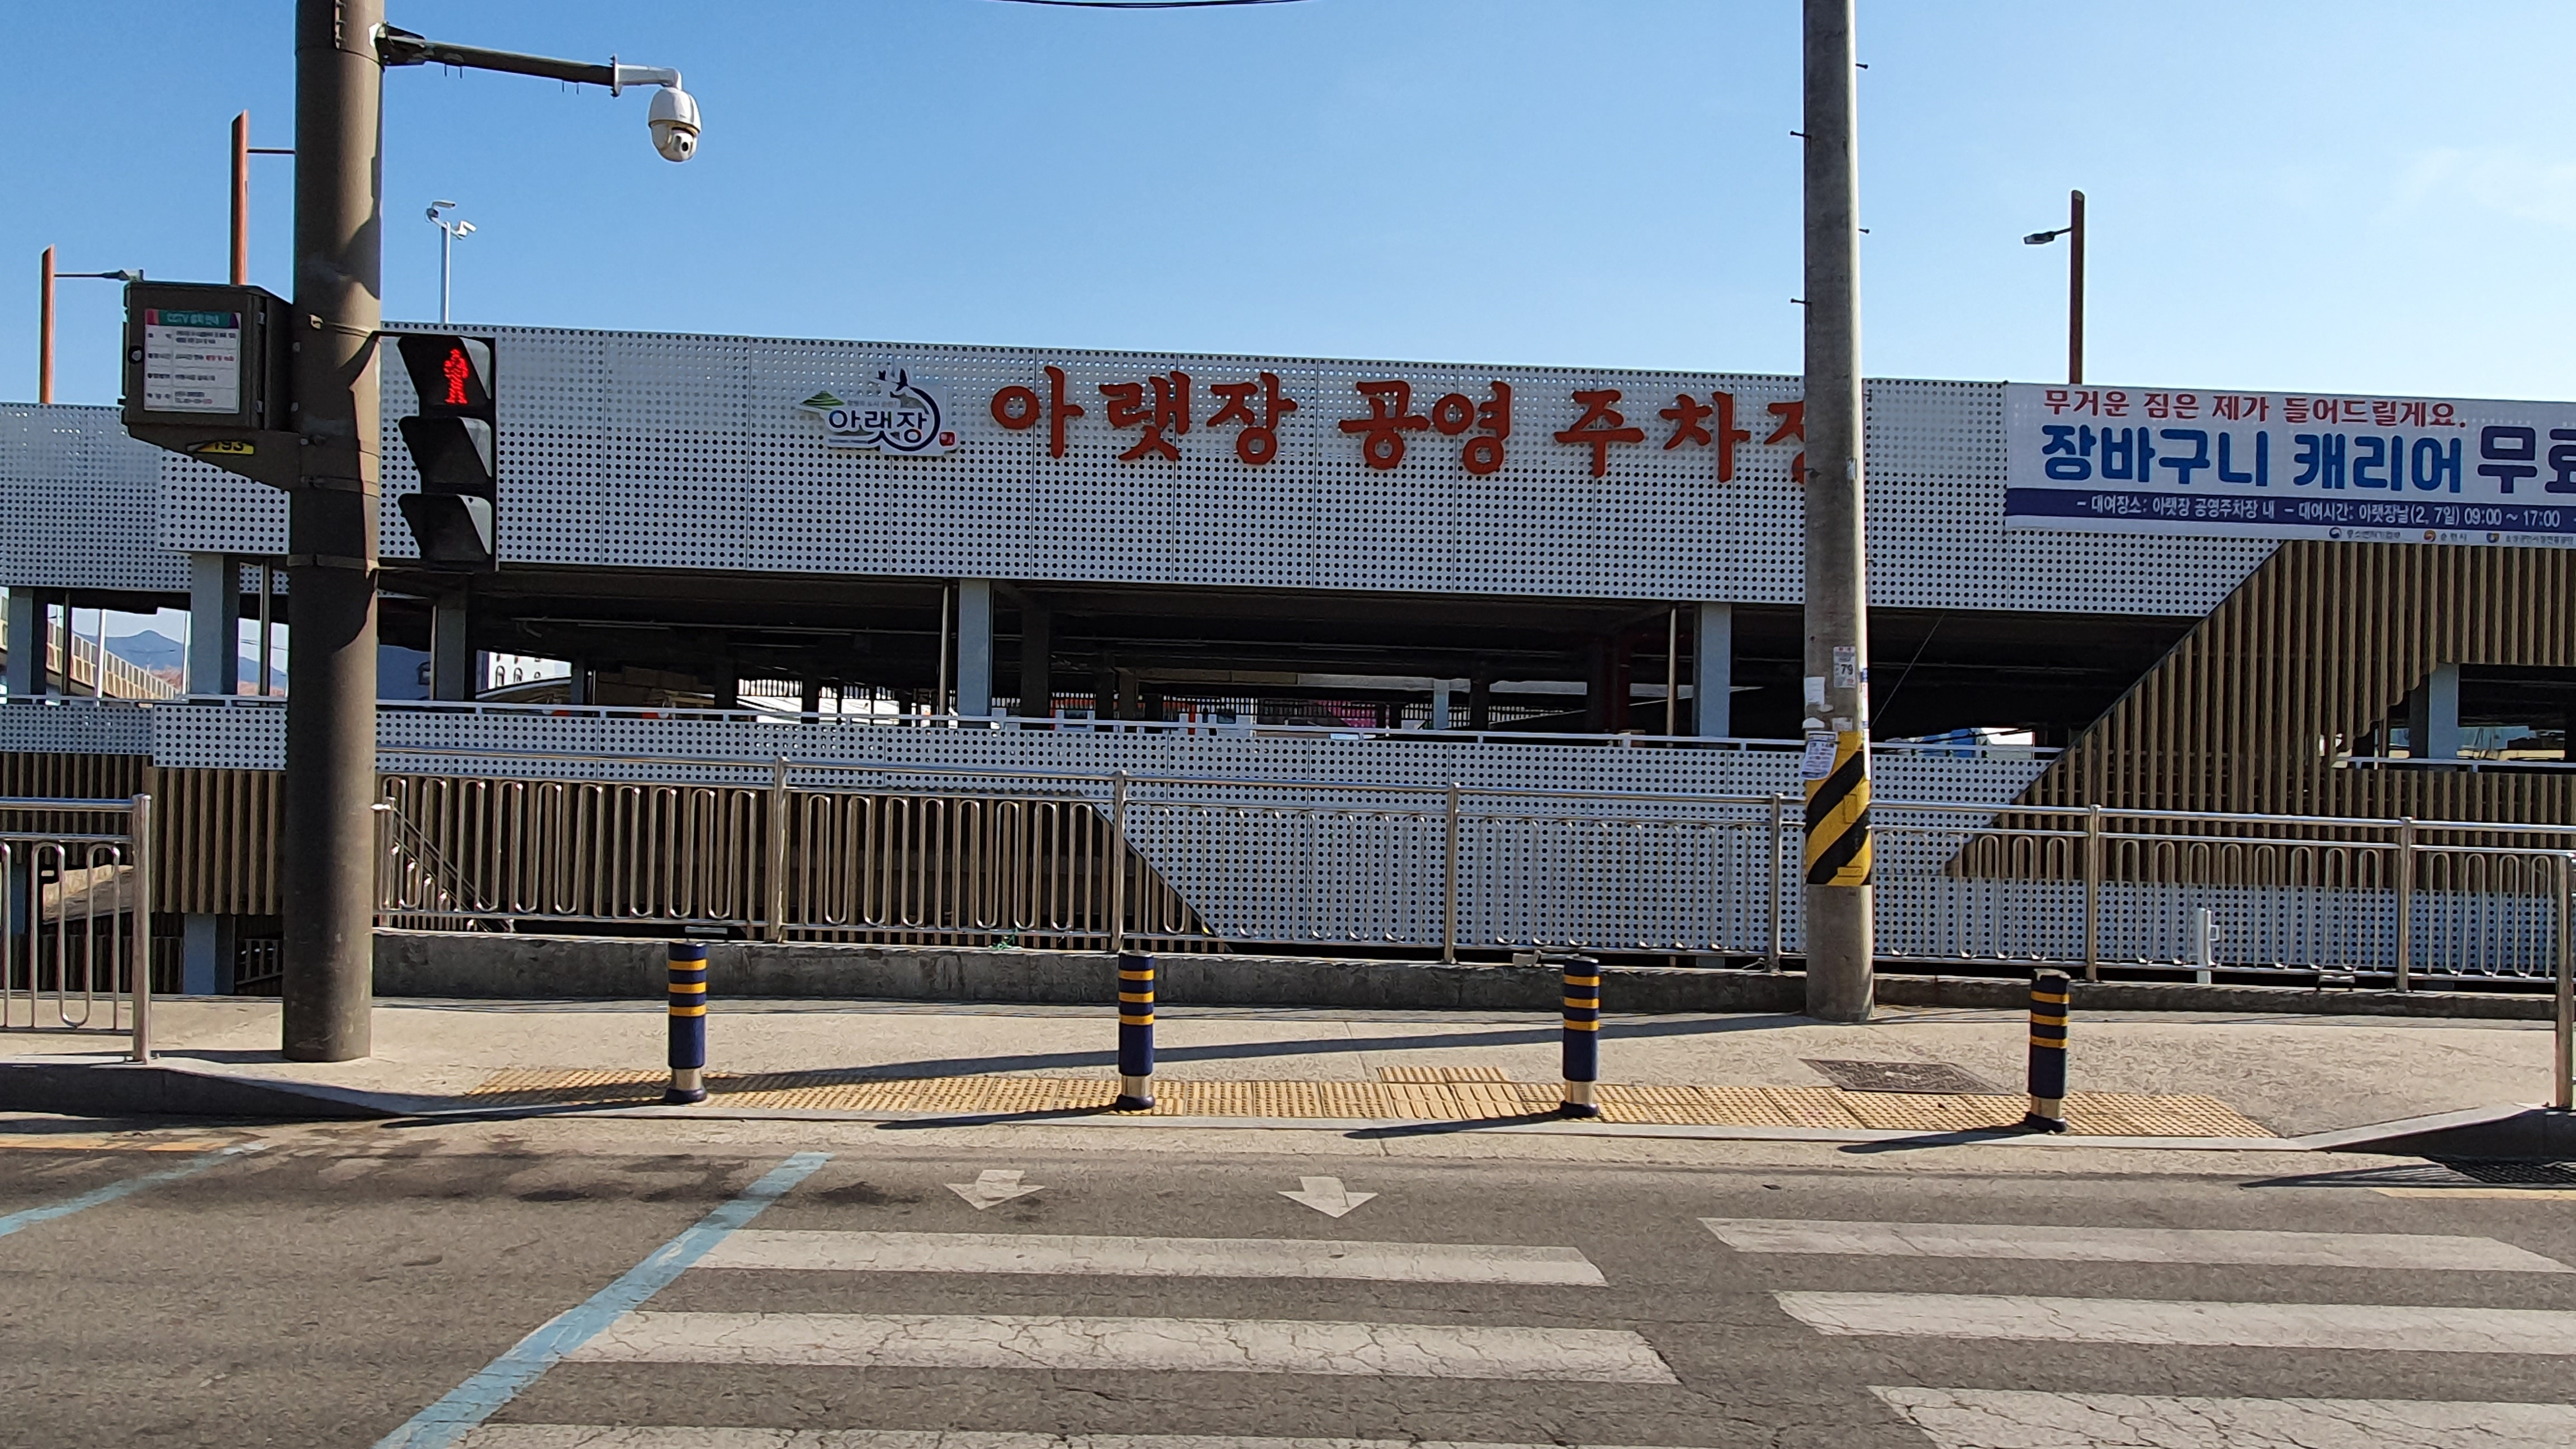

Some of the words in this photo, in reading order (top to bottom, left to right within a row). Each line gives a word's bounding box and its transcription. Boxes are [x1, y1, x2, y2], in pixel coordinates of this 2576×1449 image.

[991, 366, 1298, 465] 아랫장
[1338, 380, 1512, 475] 공영
[2044, 390, 2130, 417] 무거운
[2144, 393, 2200, 419] 짐은
[2212, 395, 2270, 422] 제가
[2283, 397, 2466, 428] 들어드릴게요.
[2042, 424, 2269, 487] 장바구니
[2293, 433, 2462, 493] 캐리어
[2091, 495, 2147, 514] 대여장소:
[2153, 496, 2191, 517] 아랫장
[2195, 498, 2259, 519] 공영주차장
[2262, 500, 2275, 519] 내
[2298, 501, 2354, 522] 대여시간:
[2434, 505, 2460, 525] 7일)
[2464, 507, 2503, 525] 09:00
[2523, 509, 2560, 528] 17:00
[1841, 664, 1854, 675] 79
